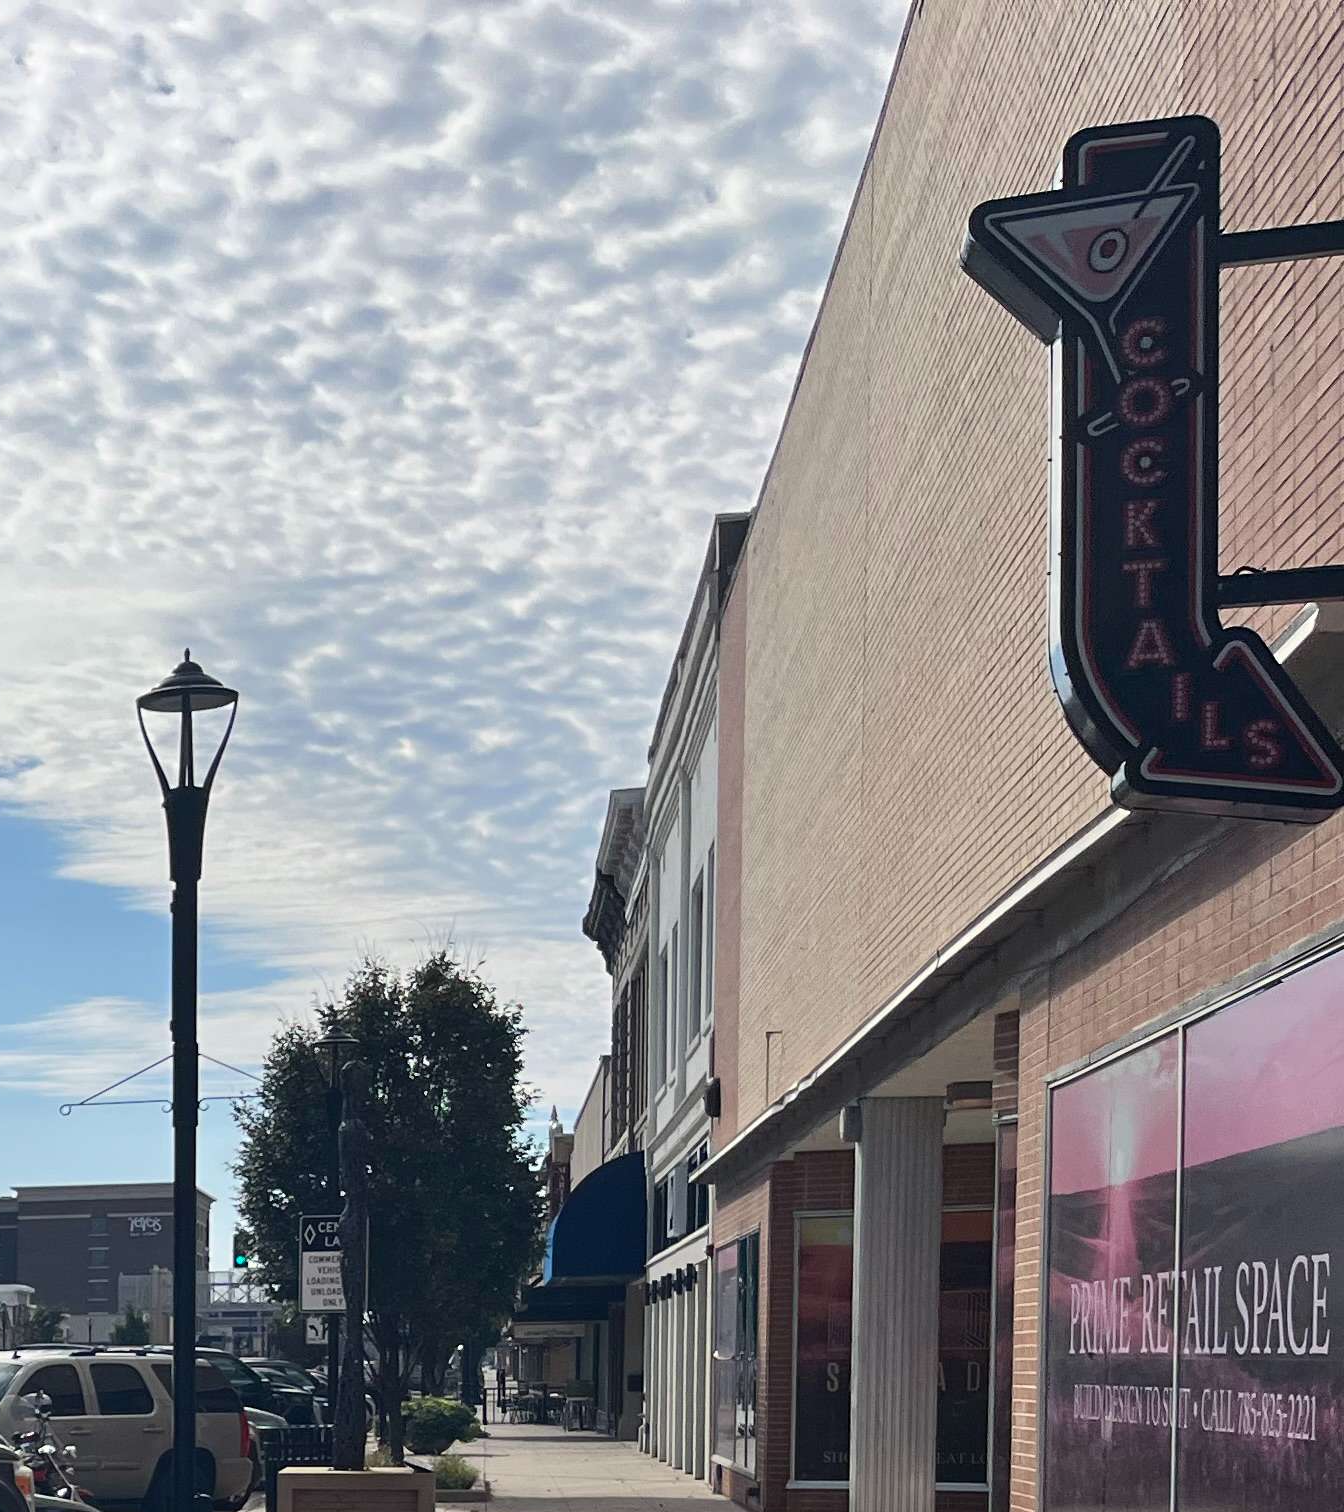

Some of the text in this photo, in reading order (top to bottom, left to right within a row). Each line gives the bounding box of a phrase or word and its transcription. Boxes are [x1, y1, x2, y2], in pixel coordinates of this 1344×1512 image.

[1119, 316, 1282, 769] COCKTAILS
[318, 1221, 340, 1233] CEN
[324, 1235, 341, 1247] LA
[308, 1255, 341, 1264] COMMER
[317, 1266, 342, 1274] VEHIC
[310, 1287, 343, 1296] UNLOAD
[1069, 1277, 1135, 1354] PRIME
[1233, 1252, 1332, 1356] SPACE
[1144, 1386, 1160, 1426] TO
[1201, 1388, 1235, 1433] CALL
[1237, 1391, 1316, 1441] 785-825-2221
